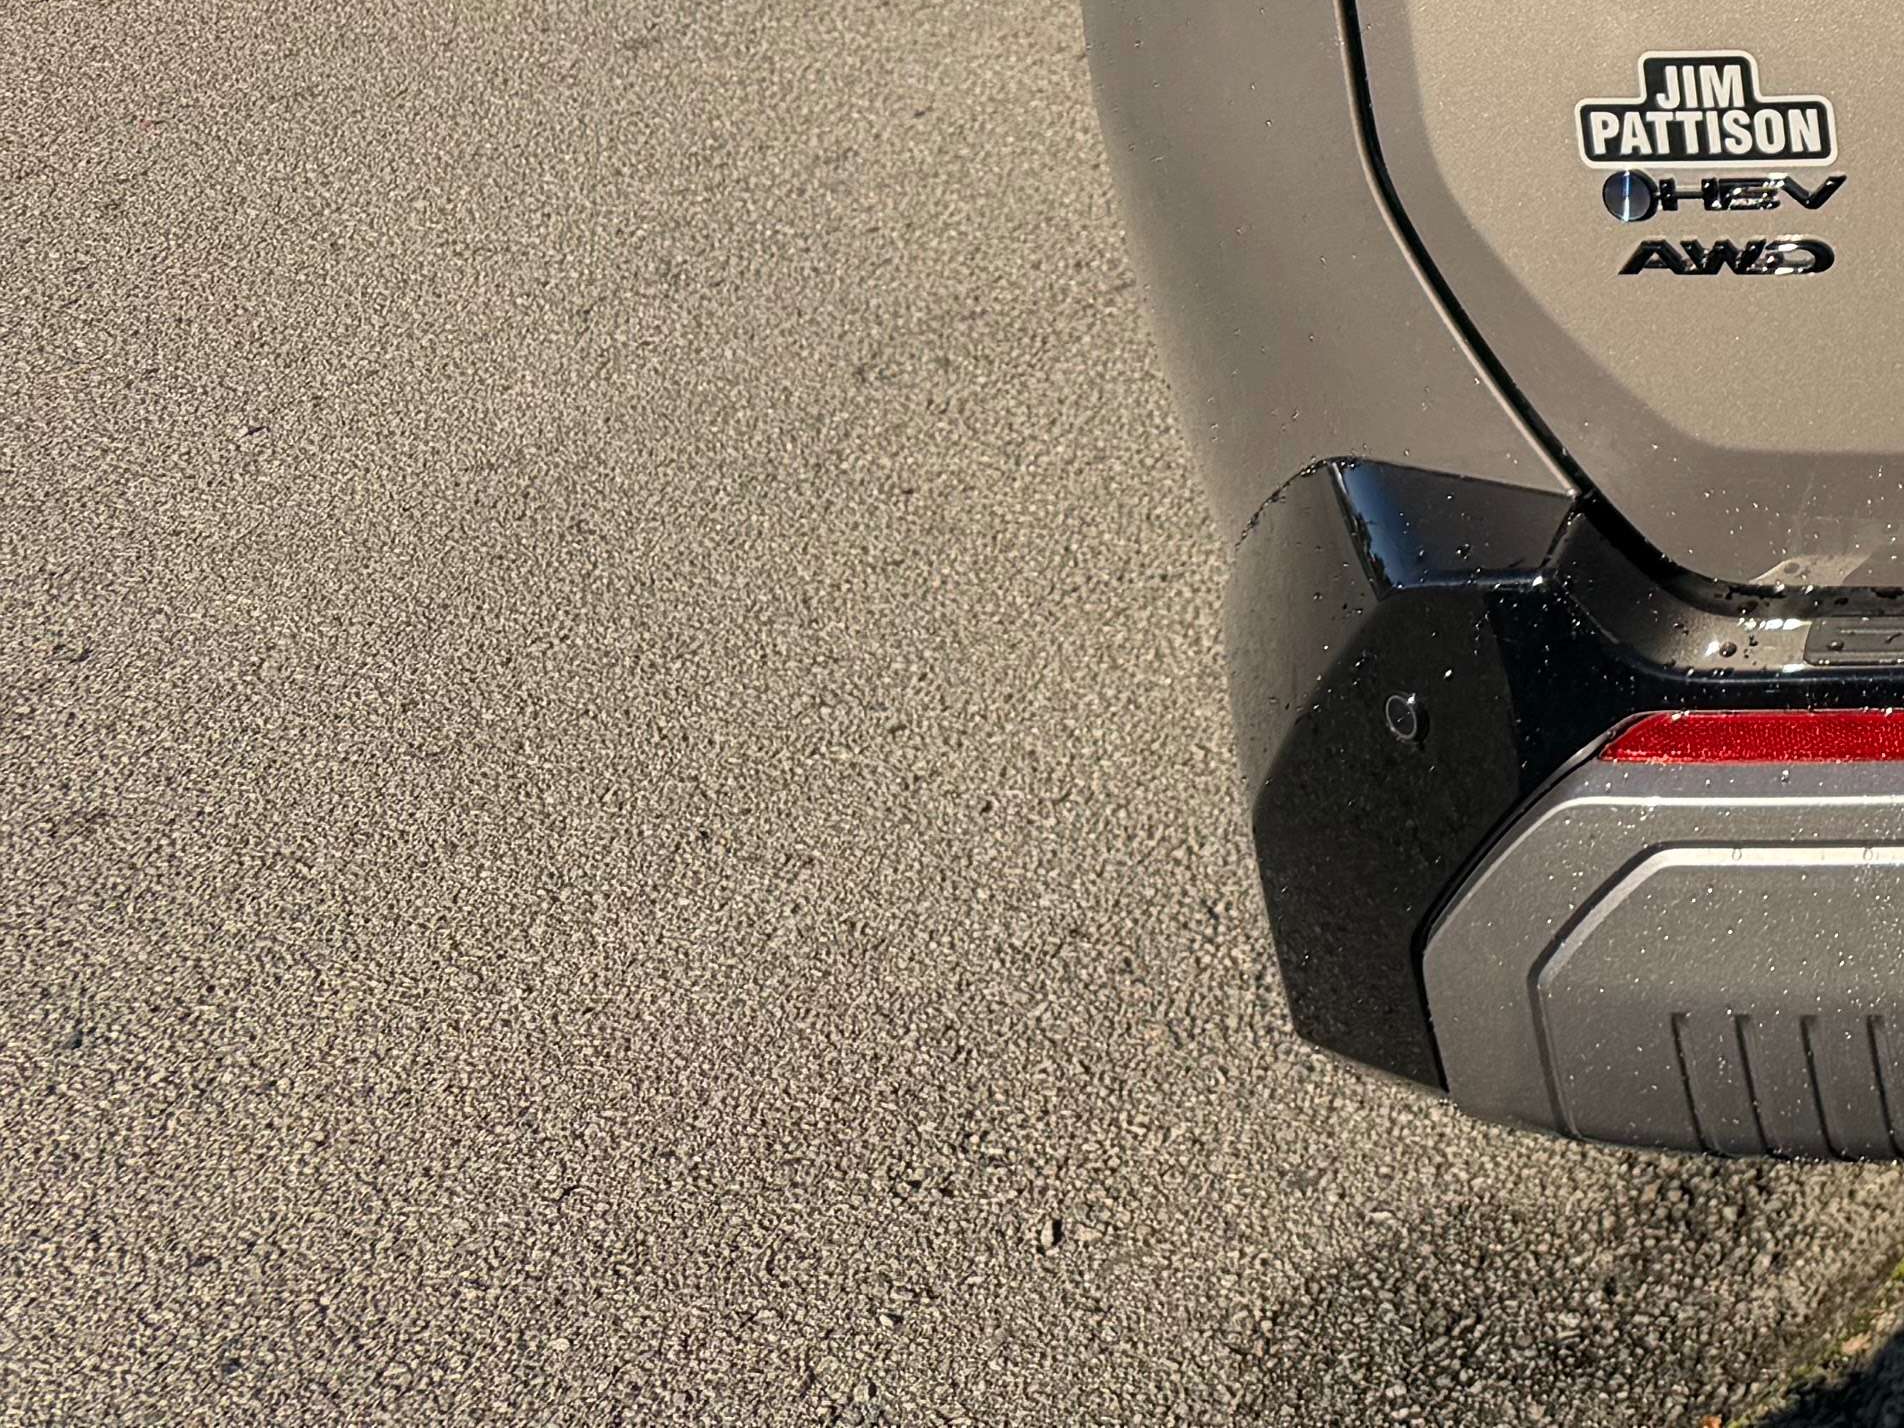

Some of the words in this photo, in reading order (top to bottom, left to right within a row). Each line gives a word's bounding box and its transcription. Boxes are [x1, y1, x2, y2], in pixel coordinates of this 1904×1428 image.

[1656, 64, 1746, 109] JIM
[1590, 108, 1822, 157] PATTISON
[1658, 171, 1847, 212] HEV
[1617, 234, 1835, 276] AWD
